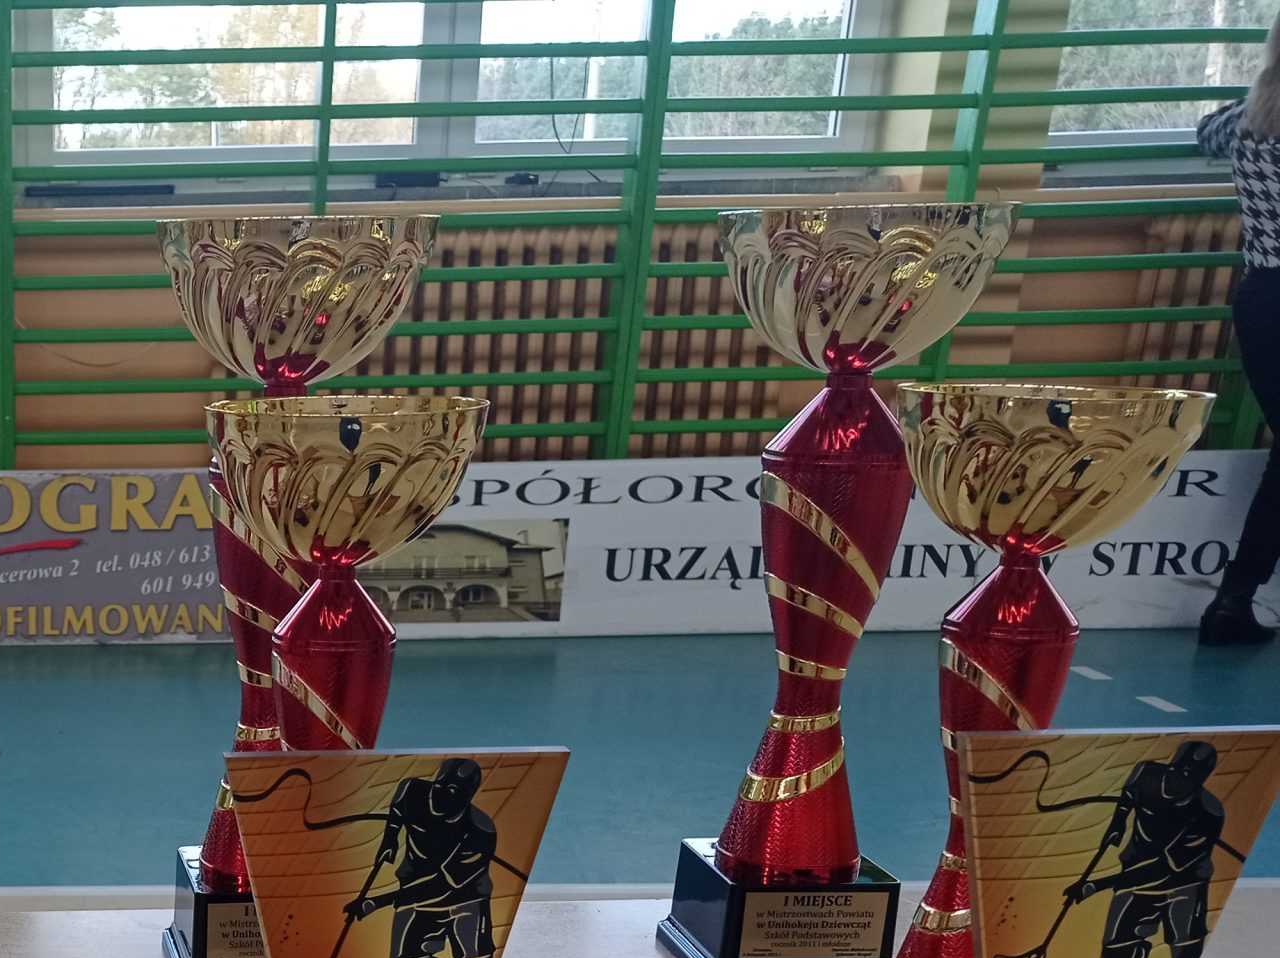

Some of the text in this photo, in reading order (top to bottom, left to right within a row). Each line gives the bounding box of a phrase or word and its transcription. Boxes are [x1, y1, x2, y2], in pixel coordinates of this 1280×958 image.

[448, 469, 761, 507] PÓŁOR
[68, 559, 81, 577] 2
[96, 554, 123, 574] tel.
[129, 550, 163, 569] 048
[178, 544, 212, 564] 613
[886, 544, 986, 579] INY
[1088, 540, 1232, 577] STRO
[140, 570, 217, 596] 601 949
[792, 895, 853, 908] MIEJSCE
[767, 910, 834, 918] Mistrzostwach
[837, 910, 874, 918] Powiatu
[767, 920, 819, 931] Unihokeju
[821, 919, 872, 930] Dziewcząt
[232, 930, 261, 939] Uniho
[763, 930, 860, 940] Szkół Podstawowych
[771, 940, 797, 948] rocznik
